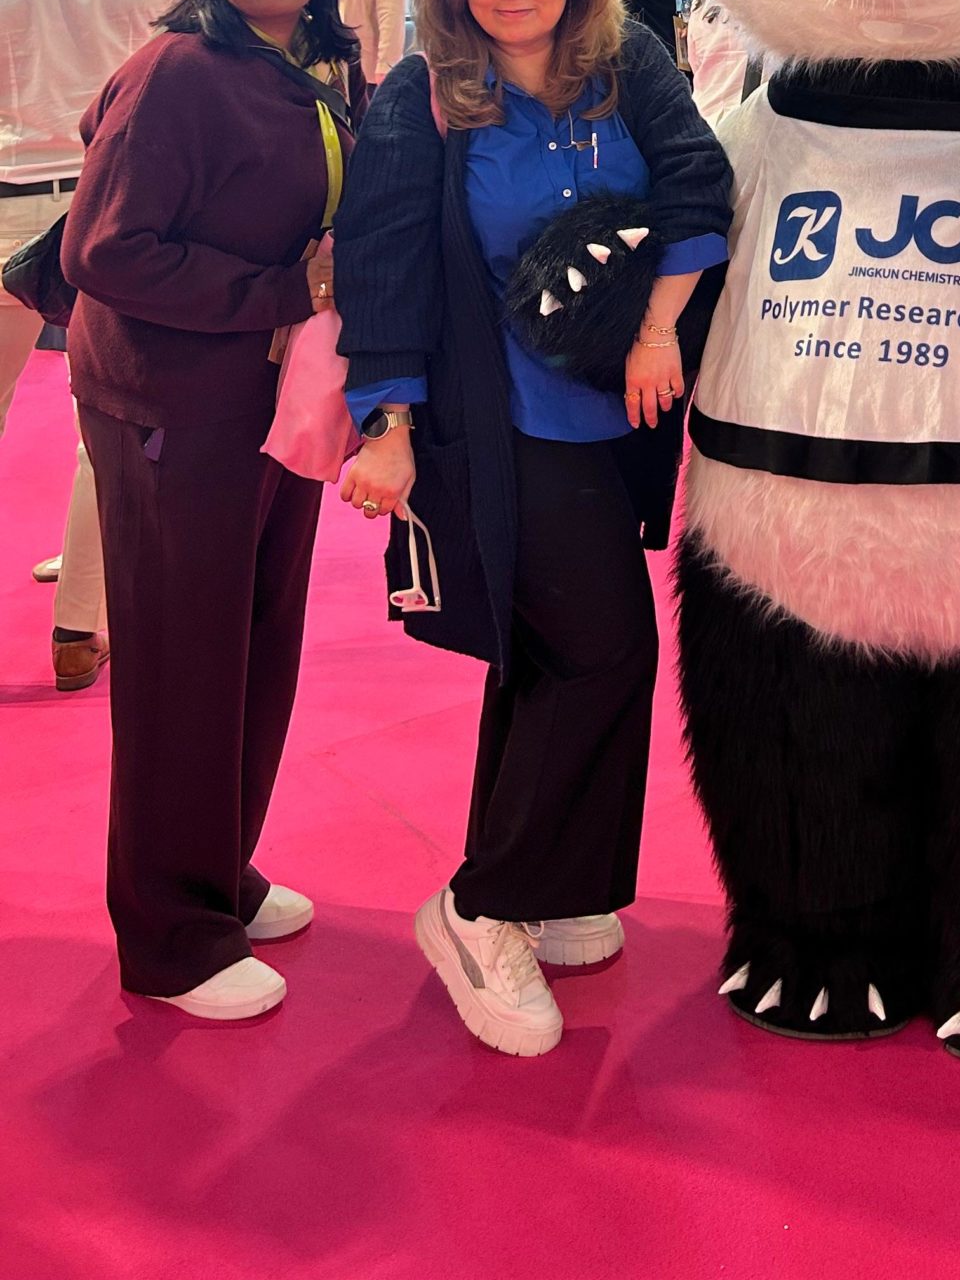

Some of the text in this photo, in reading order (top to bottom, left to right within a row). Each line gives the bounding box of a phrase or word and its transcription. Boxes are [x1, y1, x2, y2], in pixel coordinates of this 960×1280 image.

[848, 266, 900, 280] JINGKUN
[761, 295, 850, 323] Polymer
[794, 333, 949, 368] since 1989
